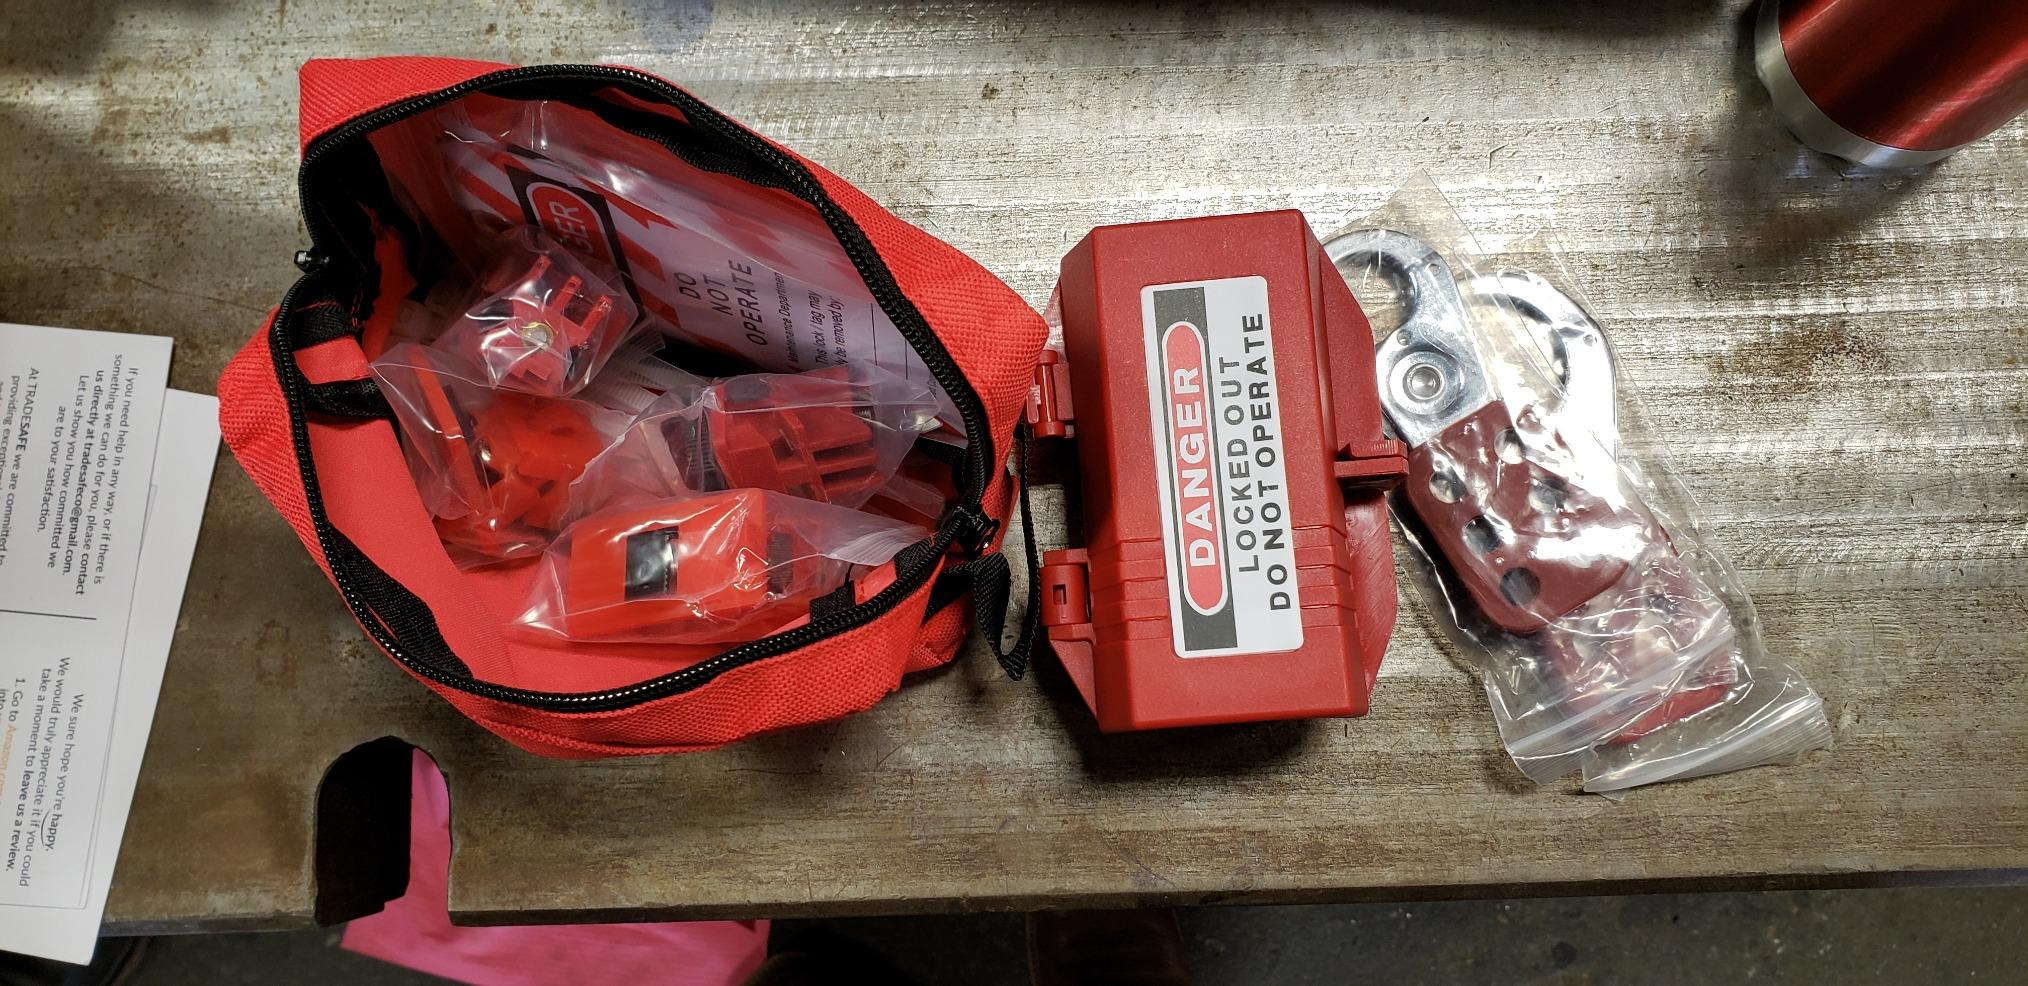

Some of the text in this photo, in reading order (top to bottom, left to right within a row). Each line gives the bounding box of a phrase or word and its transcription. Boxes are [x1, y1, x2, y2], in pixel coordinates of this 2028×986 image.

[674, 271, 702, 301] DO
[702, 273, 734, 317] NOT
[727, 259, 768, 347] OPERATE
[807, 290, 823, 311] may
[774, 272, 799, 363] Maintenance Departmen
[809, 310, 825, 325] tag
[828, 309, 846, 346] removed
[28, 367, 40, 380] At
[815, 348, 828, 365] This
[833, 346, 846, 358] be
[94, 370, 105, 383] us
[2, 375, 20, 426] providing
[15, 383, 38, 452] TRADESAFE
[86, 385, 104, 427] directly
[85, 427, 96, 440] at
[8, 472, 19, 491] are
[12, 453, 22, 471] we
[37, 405, 66, 533] are to your satisfaction.
[47, 375, 90, 569] Let us show you how committed we
[75, 354, 123, 595] something we can do for you, please contact
[93, 367, 139, 585] If you need help in any way, or if there is
[1173, 367, 1216, 567] DANGER
[1218, 356, 1260, 572] LOCKED OUT
[1241, 313, 1291, 611] DO NOT OPERATE
[0, 492, 15, 552] committed
[11, 690, 24, 708] Go
[14, 678, 26, 688] 1.
[8, 710, 20, 722] to
[5, 668, 52, 872] take a moment to leave us a review.
[18, 657, 71, 887] We would truly appreciate it if you could
[44, 693, 85, 852] We sure hope you're happy.
